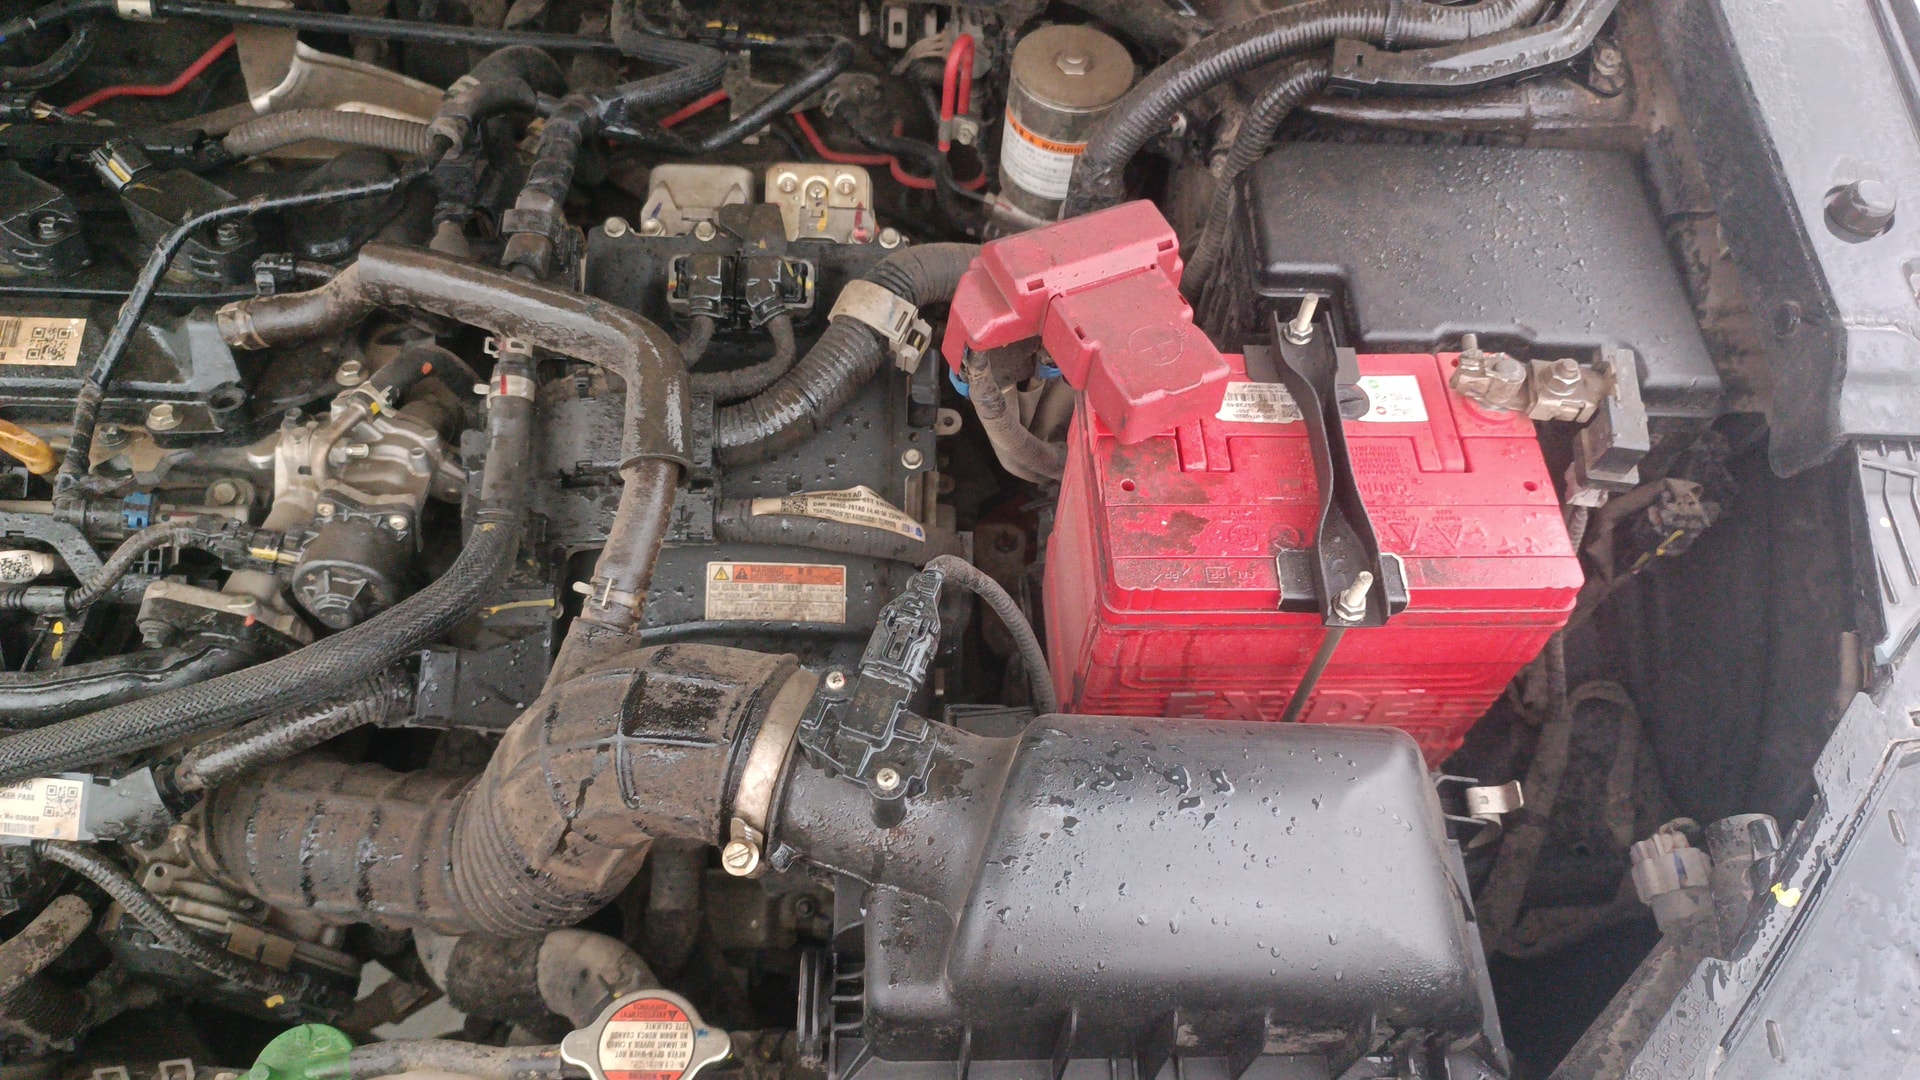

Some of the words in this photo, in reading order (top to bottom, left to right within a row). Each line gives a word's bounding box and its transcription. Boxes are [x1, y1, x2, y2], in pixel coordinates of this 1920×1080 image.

[1163, 689, 1426, 723] EXDE
[615, 1050, 627, 1058] HOT
[667, 1050, 686, 1058] NEVER
